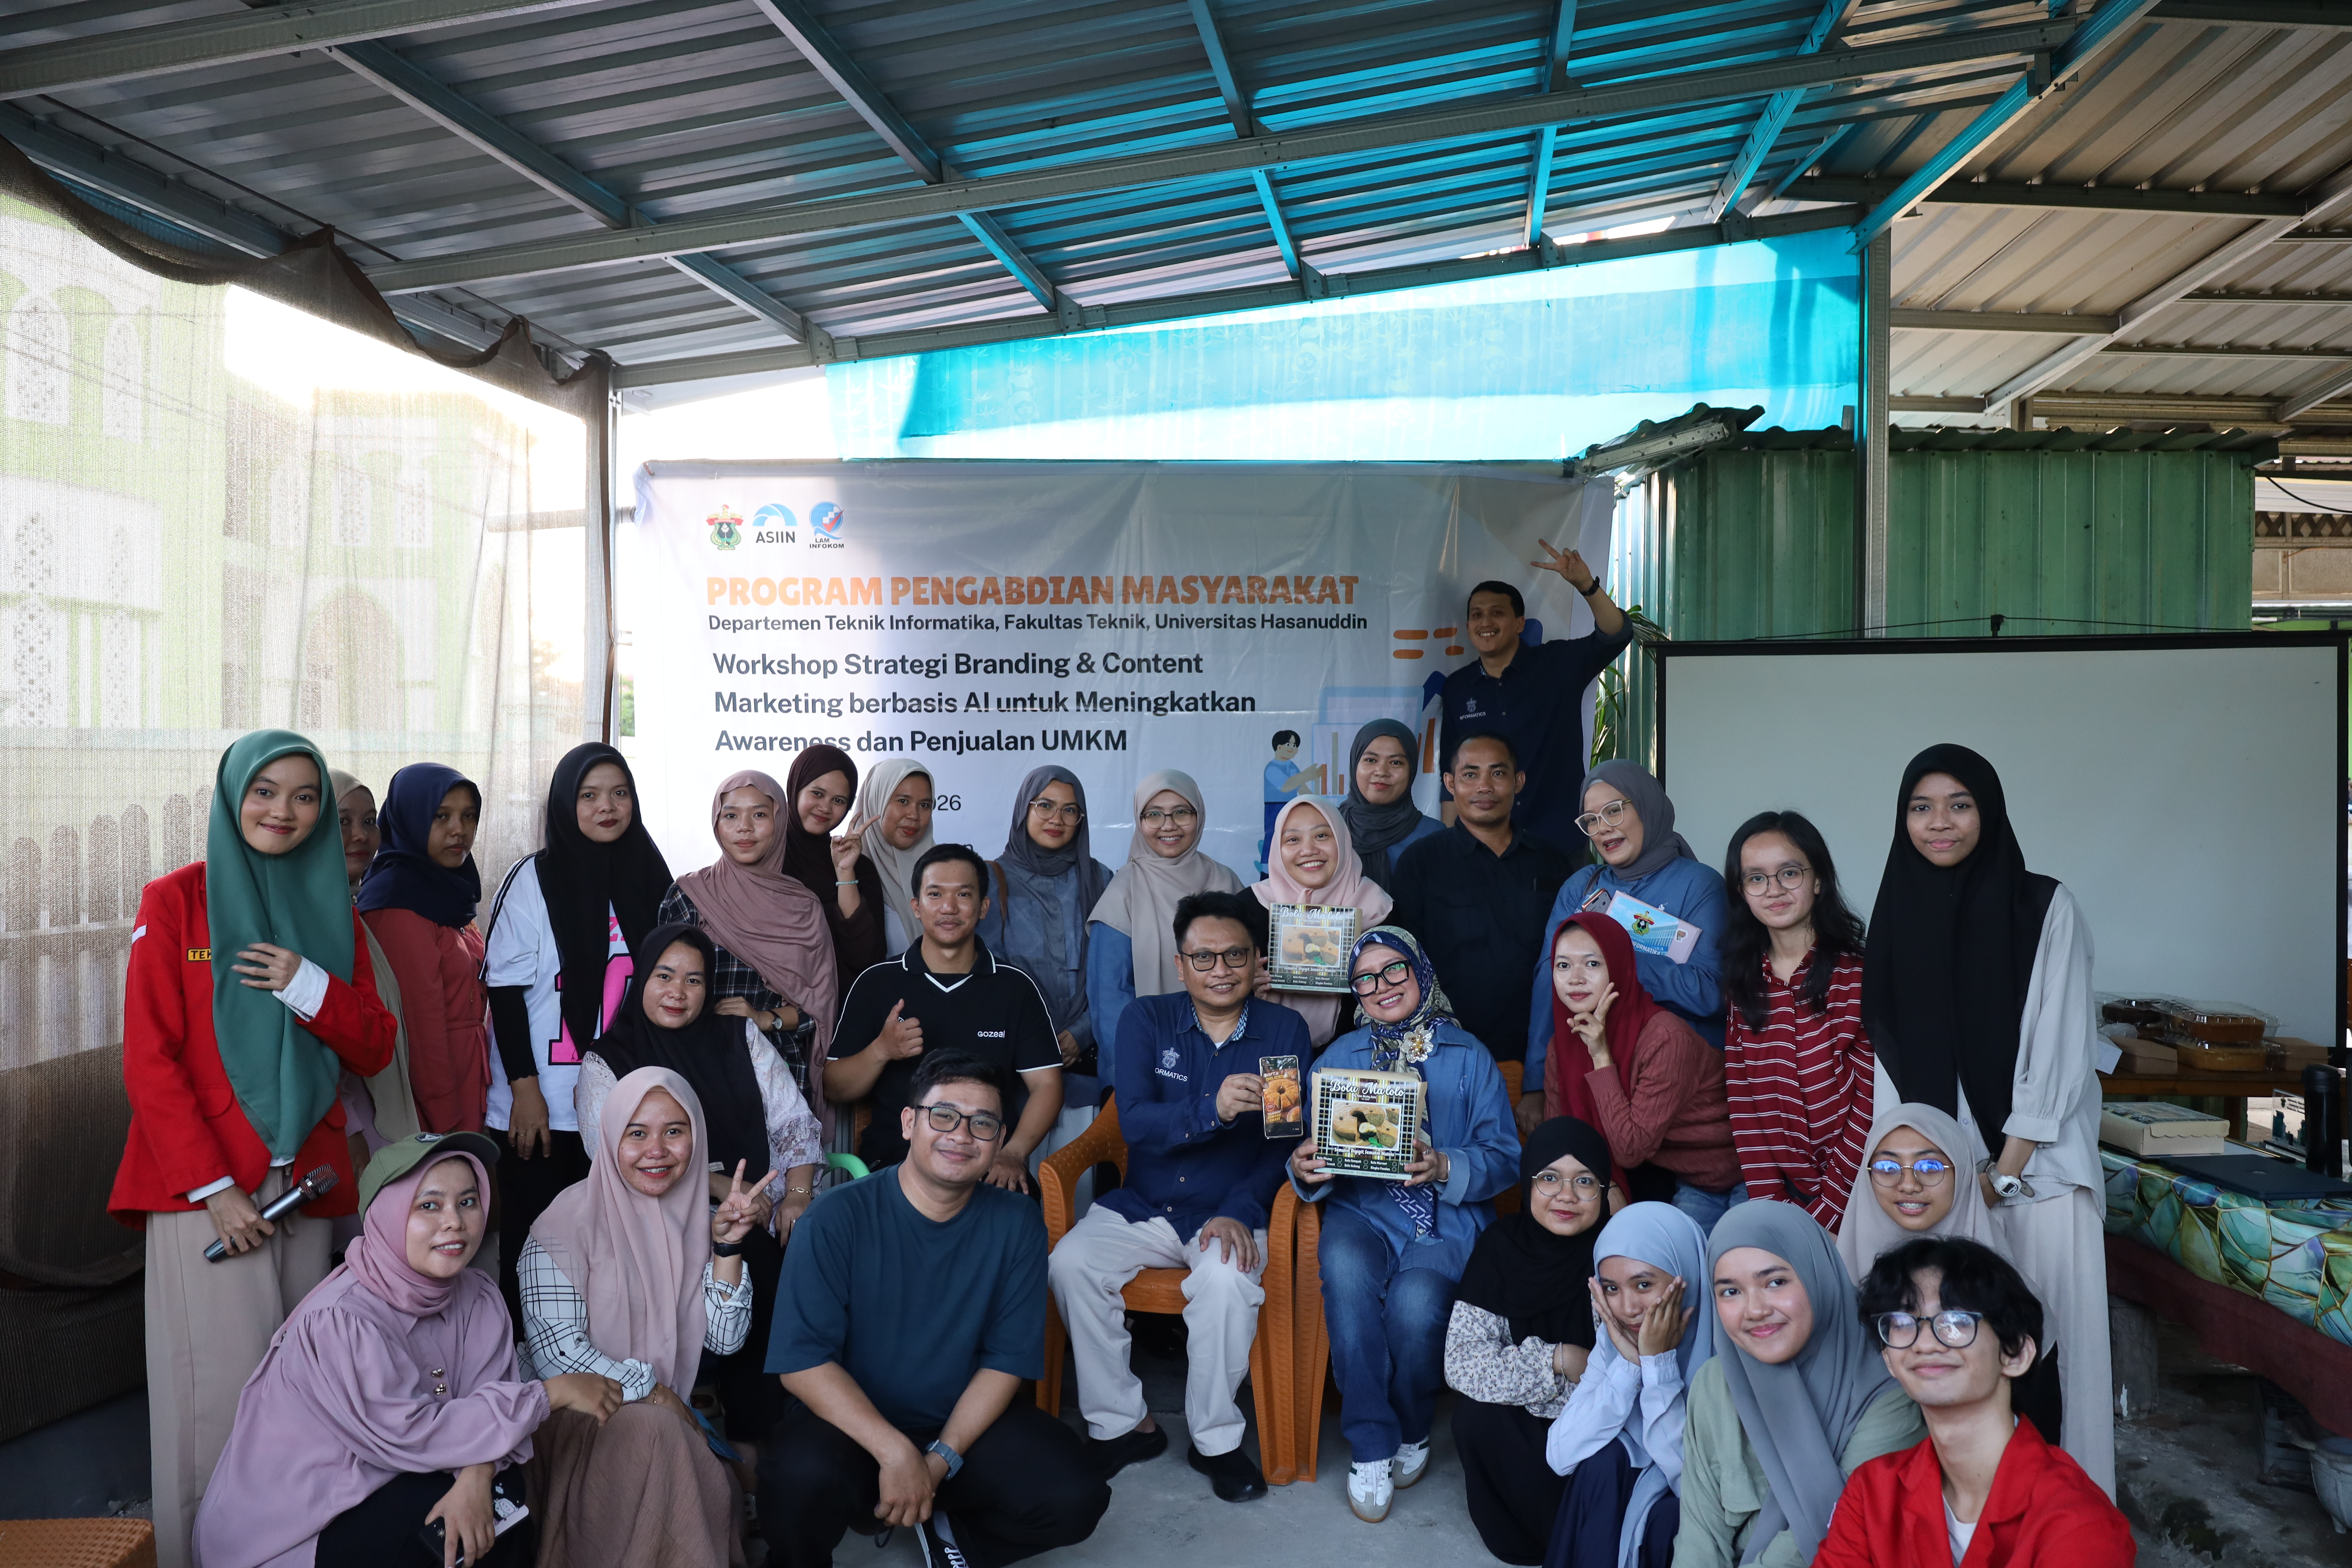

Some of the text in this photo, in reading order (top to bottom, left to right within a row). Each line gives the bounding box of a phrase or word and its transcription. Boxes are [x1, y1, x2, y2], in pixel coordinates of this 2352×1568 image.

[756, 531, 795, 543] ASIIN
[707, 575, 1358, 606] PROGRAM PENGABDIAN MASYARAKAT
[709, 613, 1367, 634] Departemen Teknik Informatika, Fakultas Teknik, Universitas Hasanuddin
[712, 652, 1203, 679] Workshop Strategi Branding & Content
[715, 690, 1256, 718] Marketing berbasis AI untuk Meningkatkan
[715, 729, 1127, 756] Awareness dan Penjualan UMKM
[1280, 907, 1304, 918] Bolu
[1155, 1067, 1188, 1082] ORMATICS
[1329, 1079, 1359, 1093] Bolu
